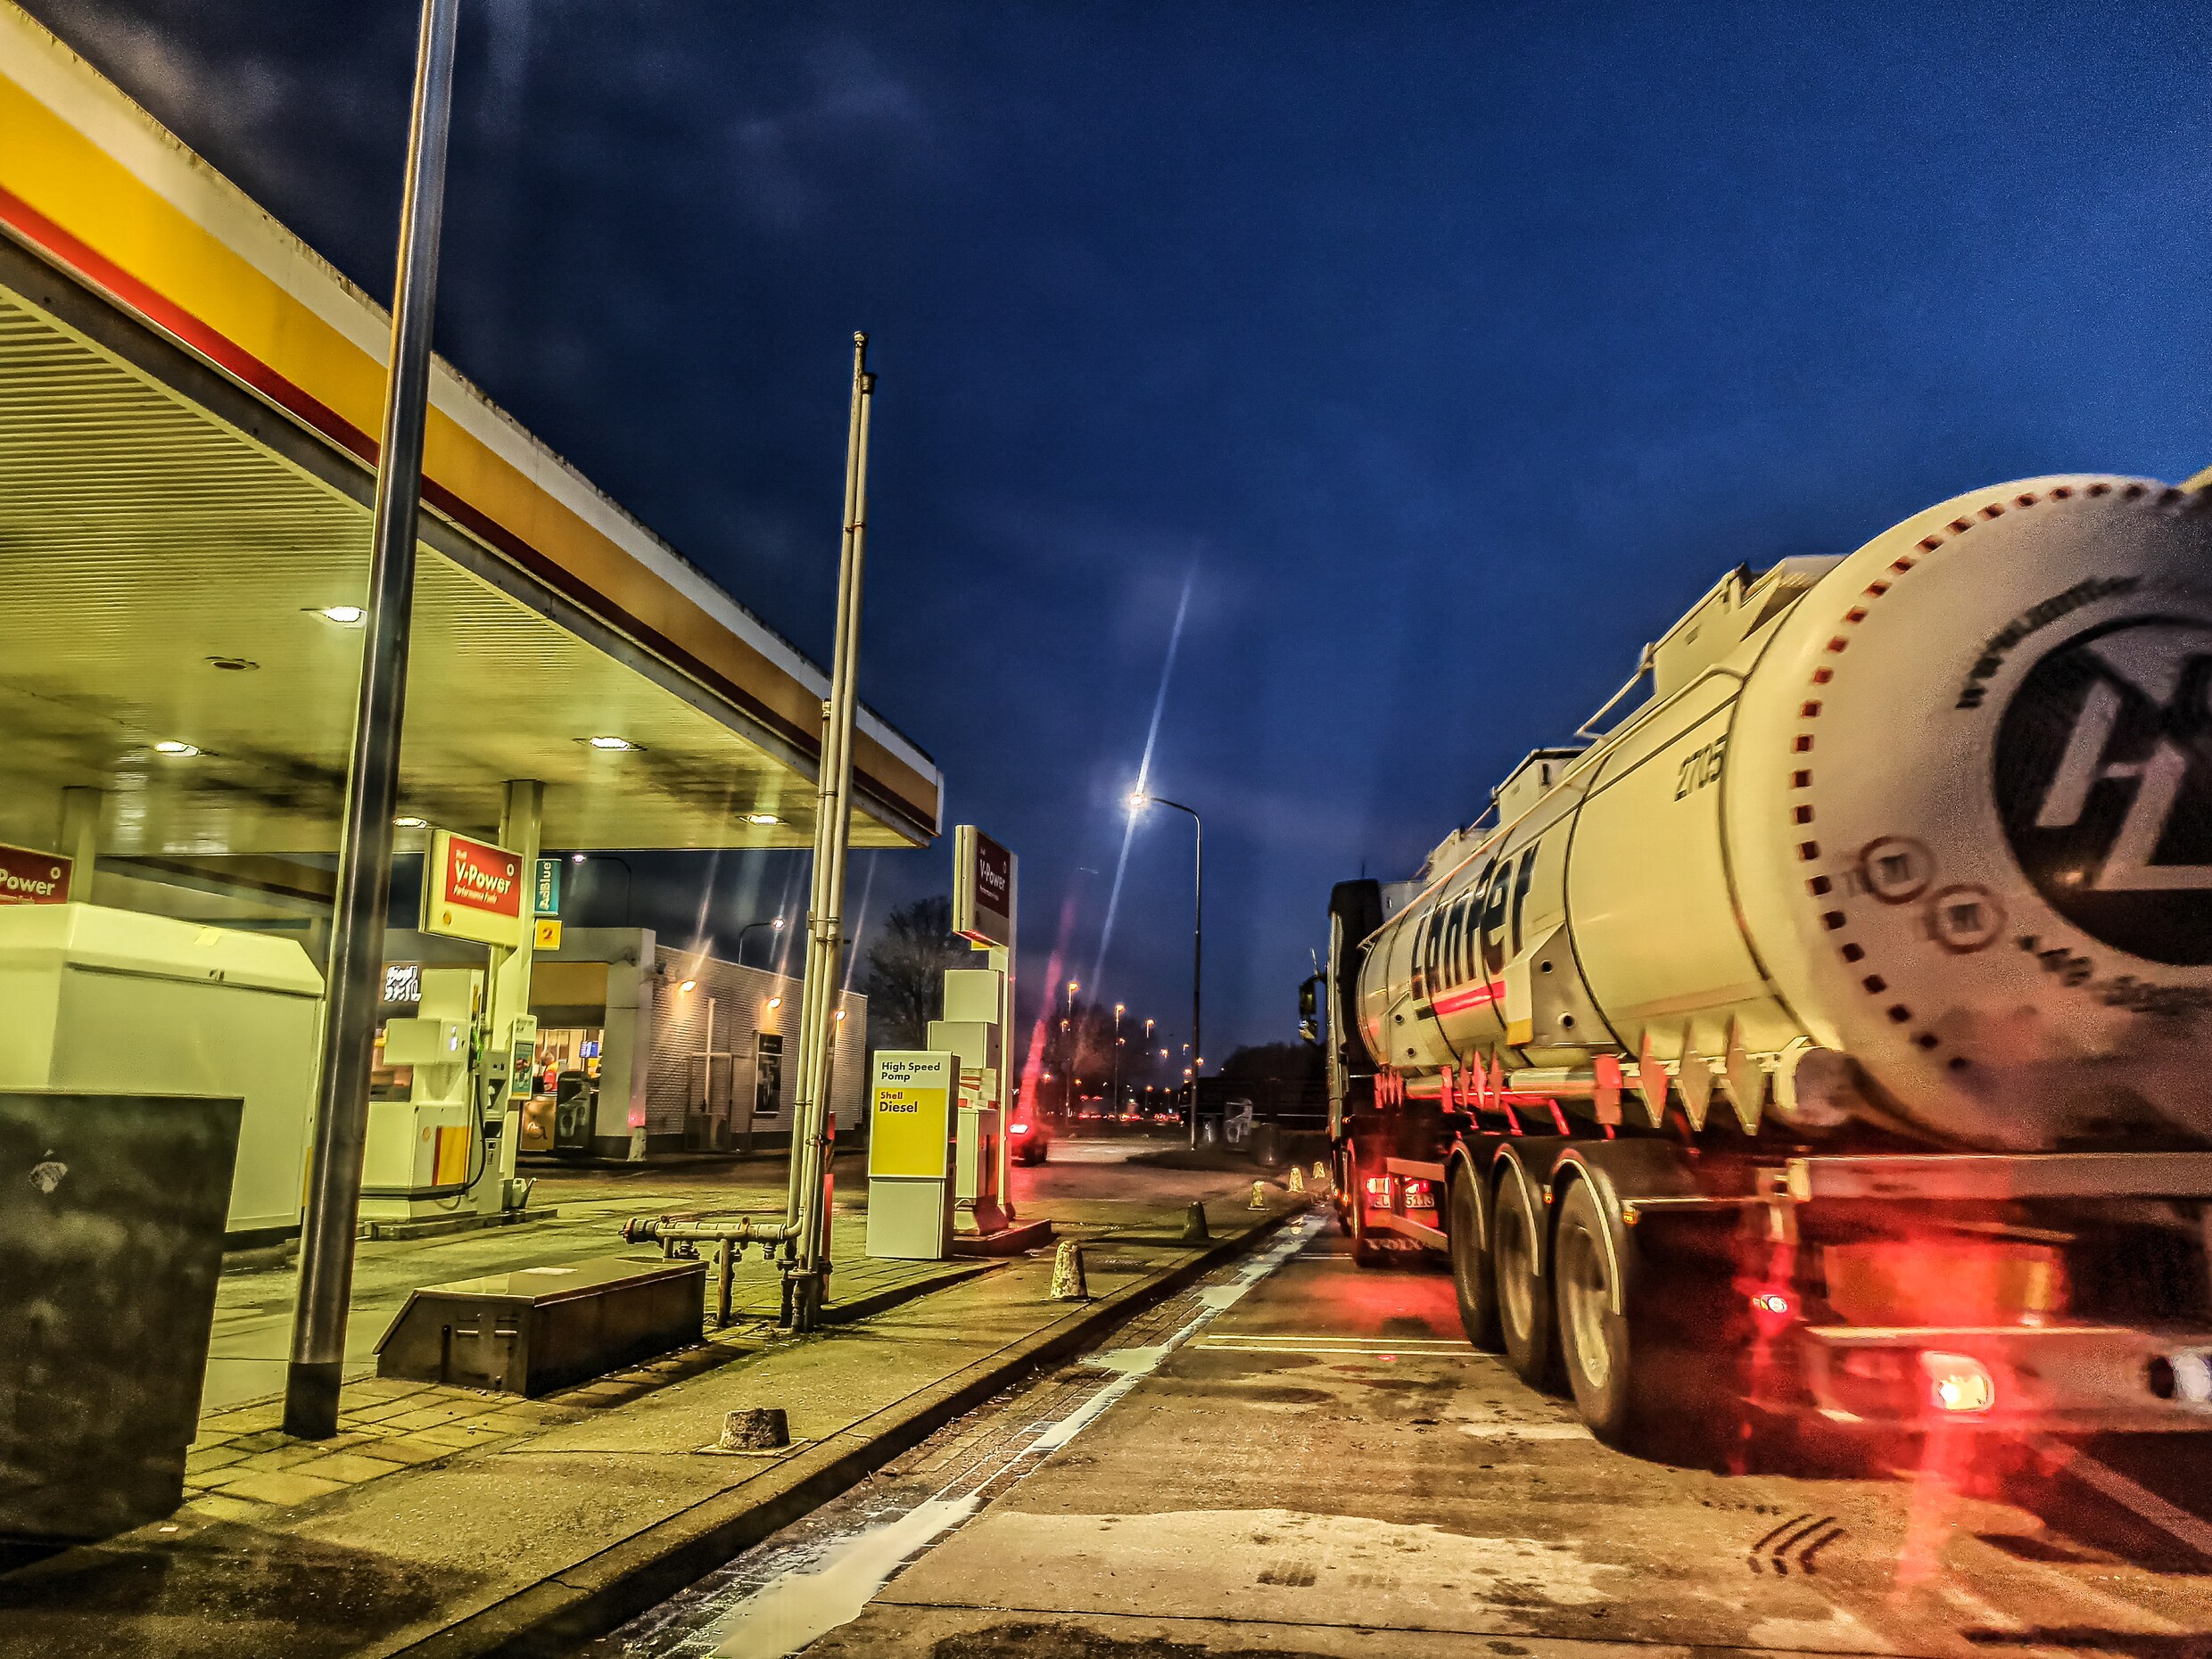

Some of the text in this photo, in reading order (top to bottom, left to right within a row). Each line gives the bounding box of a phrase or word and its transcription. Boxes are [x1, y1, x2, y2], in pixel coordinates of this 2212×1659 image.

[455, 860, 511, 895] V-Power
[979, 859, 1006, 891] V-Power
[540, 862, 552, 911] AdBlue
[542, 927, 554, 941] 2
[881, 1061, 941, 1073] High Speed
[881, 1071, 911, 1083] Pomp
[880, 1091, 904, 1100] Shell
[879, 1101, 918, 1113] Diesel
